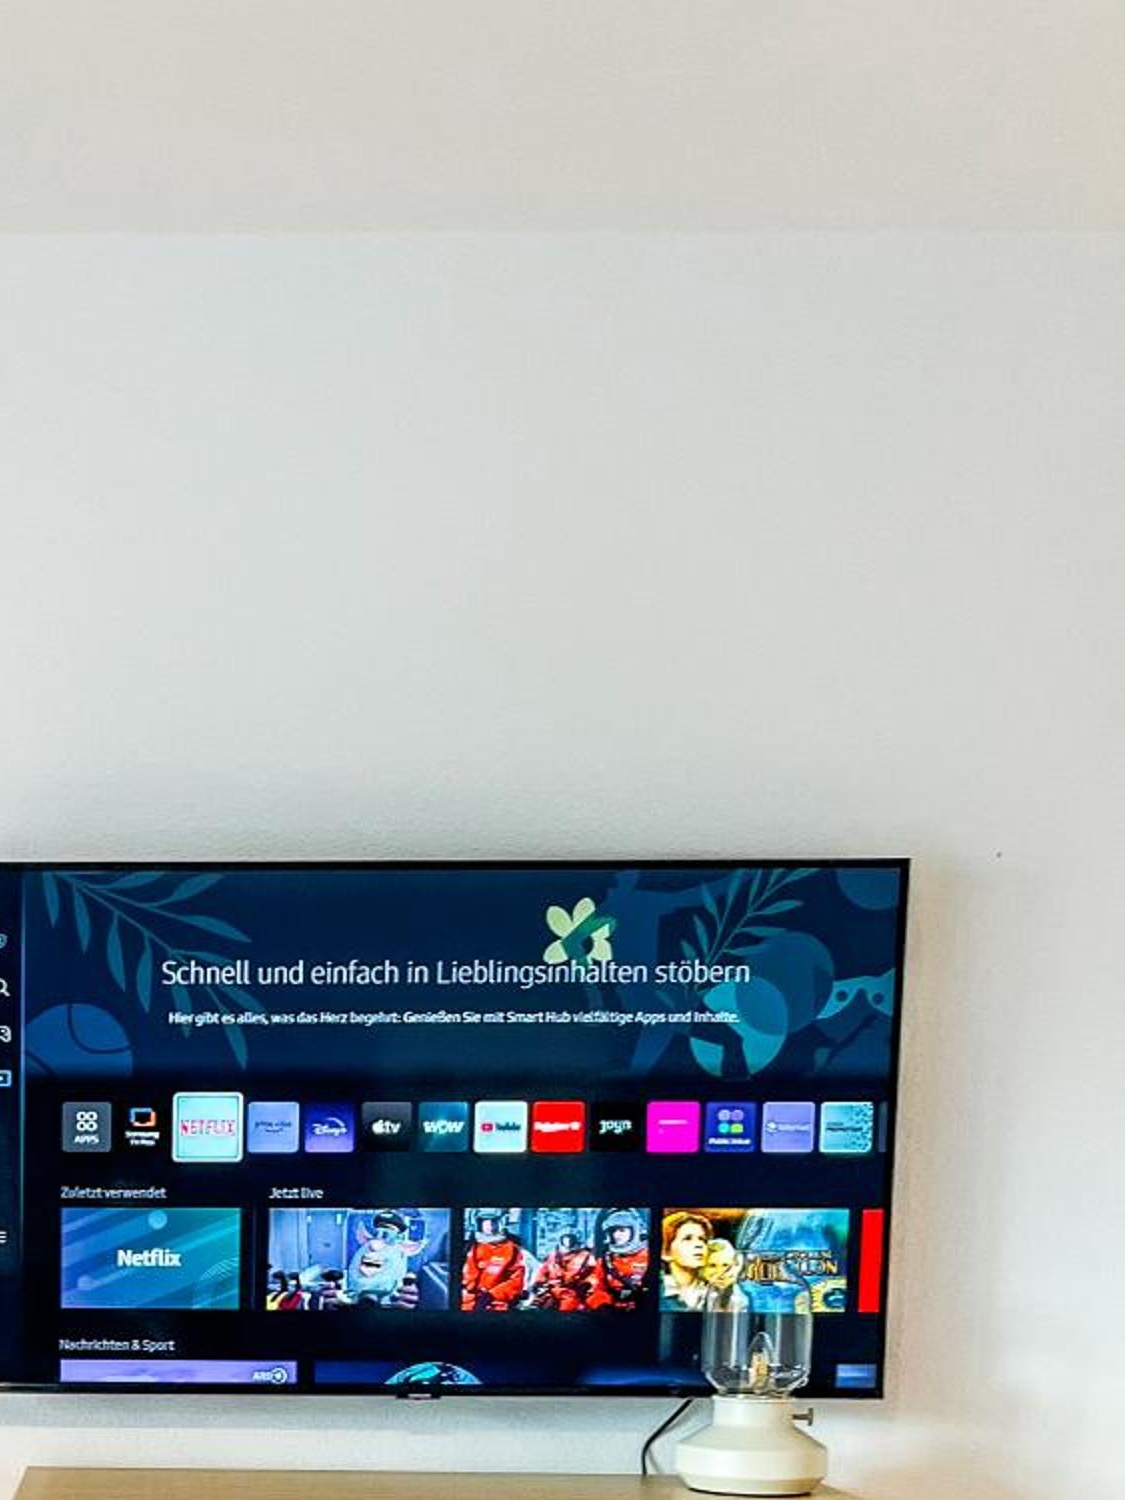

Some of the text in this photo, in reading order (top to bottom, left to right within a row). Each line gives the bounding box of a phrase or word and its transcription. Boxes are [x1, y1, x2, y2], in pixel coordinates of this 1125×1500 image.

[161, 958, 751, 989] Schnell und einfach in Lieblingsinhalten stöbern
[168, 1011, 739, 1027] Hier gibt es alles, was das Herz begehrt: Genießen Sie mit Smart Hub vielfältige Apps und Inhalte.
[179, 1119, 236, 1137] NETFLIX
[74, 1135, 100, 1145] APPS
[60, 1186, 166, 1199] Zuletzt verwendet
[268, 1187, 324, 1199] Jetzt live
[117, 1249, 182, 1268] Netflix
[59, 1338, 175, 1352] Nachrichten & Sport
